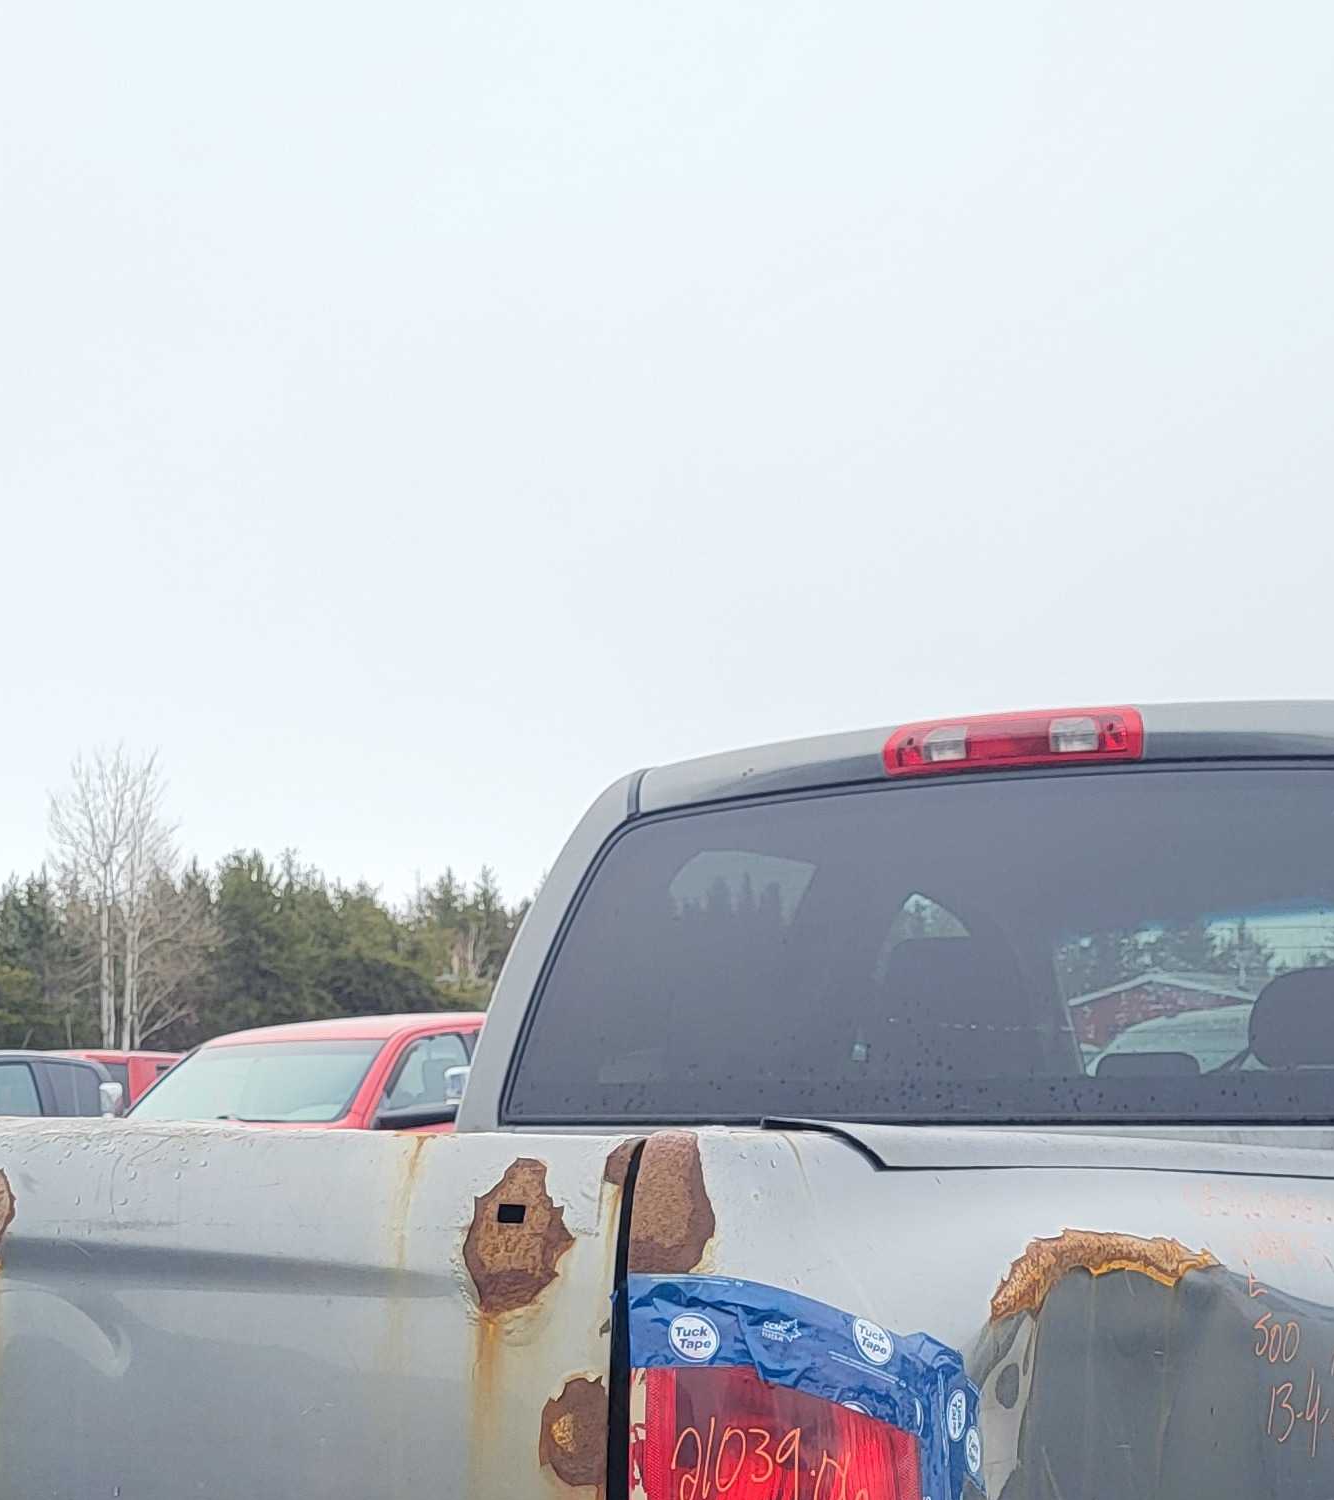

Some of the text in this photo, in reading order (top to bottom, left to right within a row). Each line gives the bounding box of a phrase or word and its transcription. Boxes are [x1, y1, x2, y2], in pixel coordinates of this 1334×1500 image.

[675, 1325, 709, 1337] Tuck
[859, 1323, 886, 1344] Tuck
[679, 1338, 712, 1351] Tape
[862, 1335, 887, 1355] Tape
